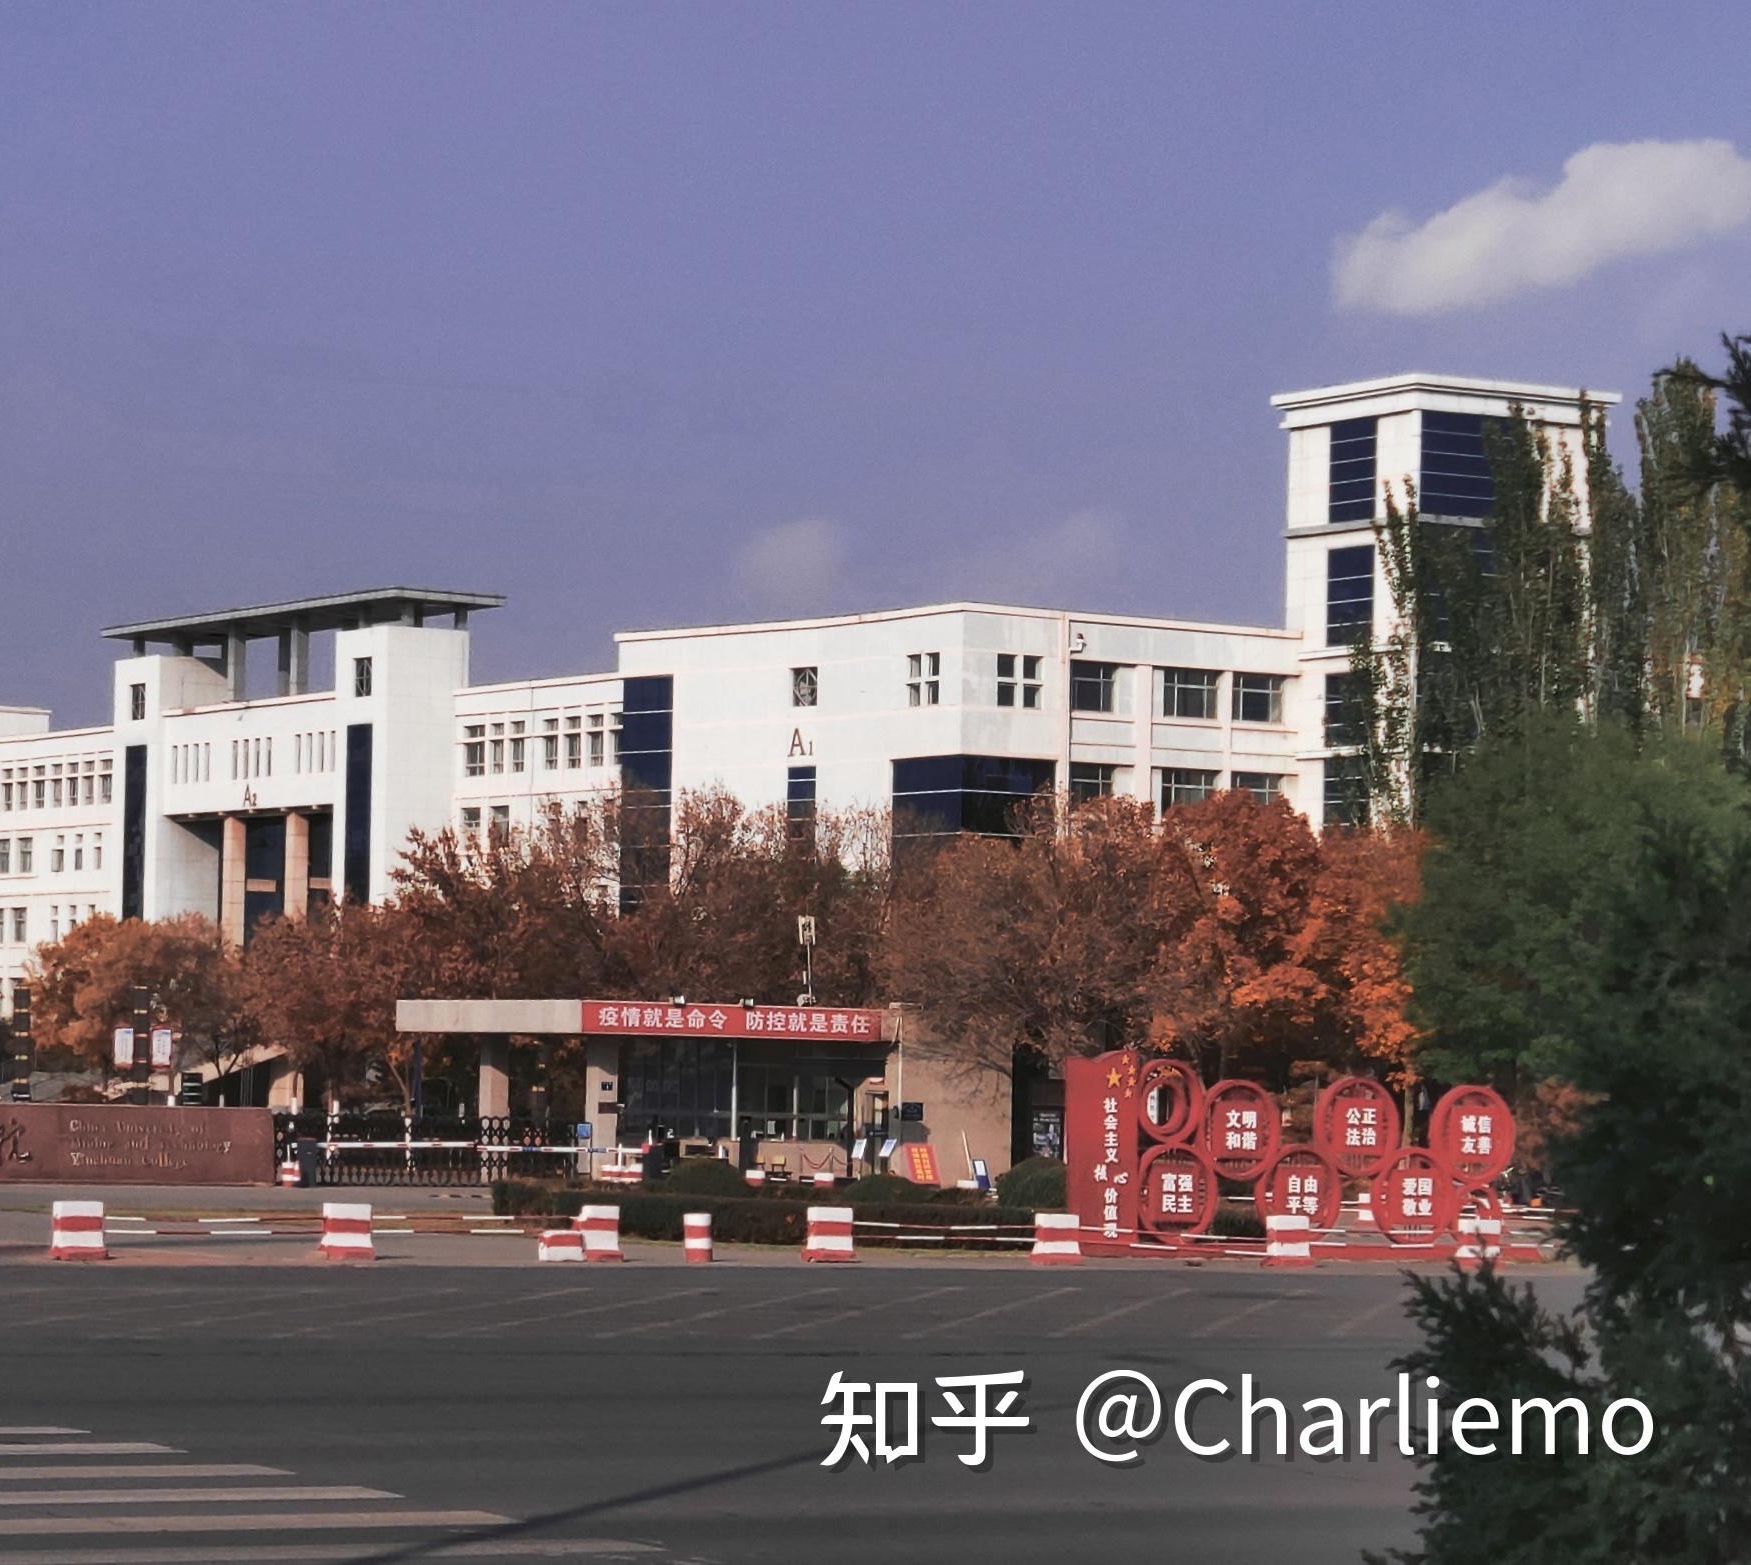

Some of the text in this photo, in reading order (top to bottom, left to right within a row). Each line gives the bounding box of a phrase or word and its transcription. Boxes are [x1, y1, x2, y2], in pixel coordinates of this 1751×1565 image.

[787, 727, 813, 757] A1
[243, 783, 257, 807] A2
[599, 1006, 871, 1034] 疫情就是命令 防控就是责任
[1225, 1109, 1257, 1128] 文明
[1345, 1107, 1377, 1125] 公正
[1460, 1115, 1492, 1134] 诚信
[1225, 1131, 1258, 1150] 和谐
[1345, 1128, 1376, 1146] 法治
[1460, 1136, 1492, 1155] 友善
[1161, 1173, 1193, 1192] 富强
[1288, 1175, 1318, 1193] 自由
[1402, 1178, 1433, 1196] 爱国
[1161, 1194, 1193, 1213] 民主
[1286, 1196, 1319, 1215] 平等
[1402, 1198, 1433, 1217] 敬业
